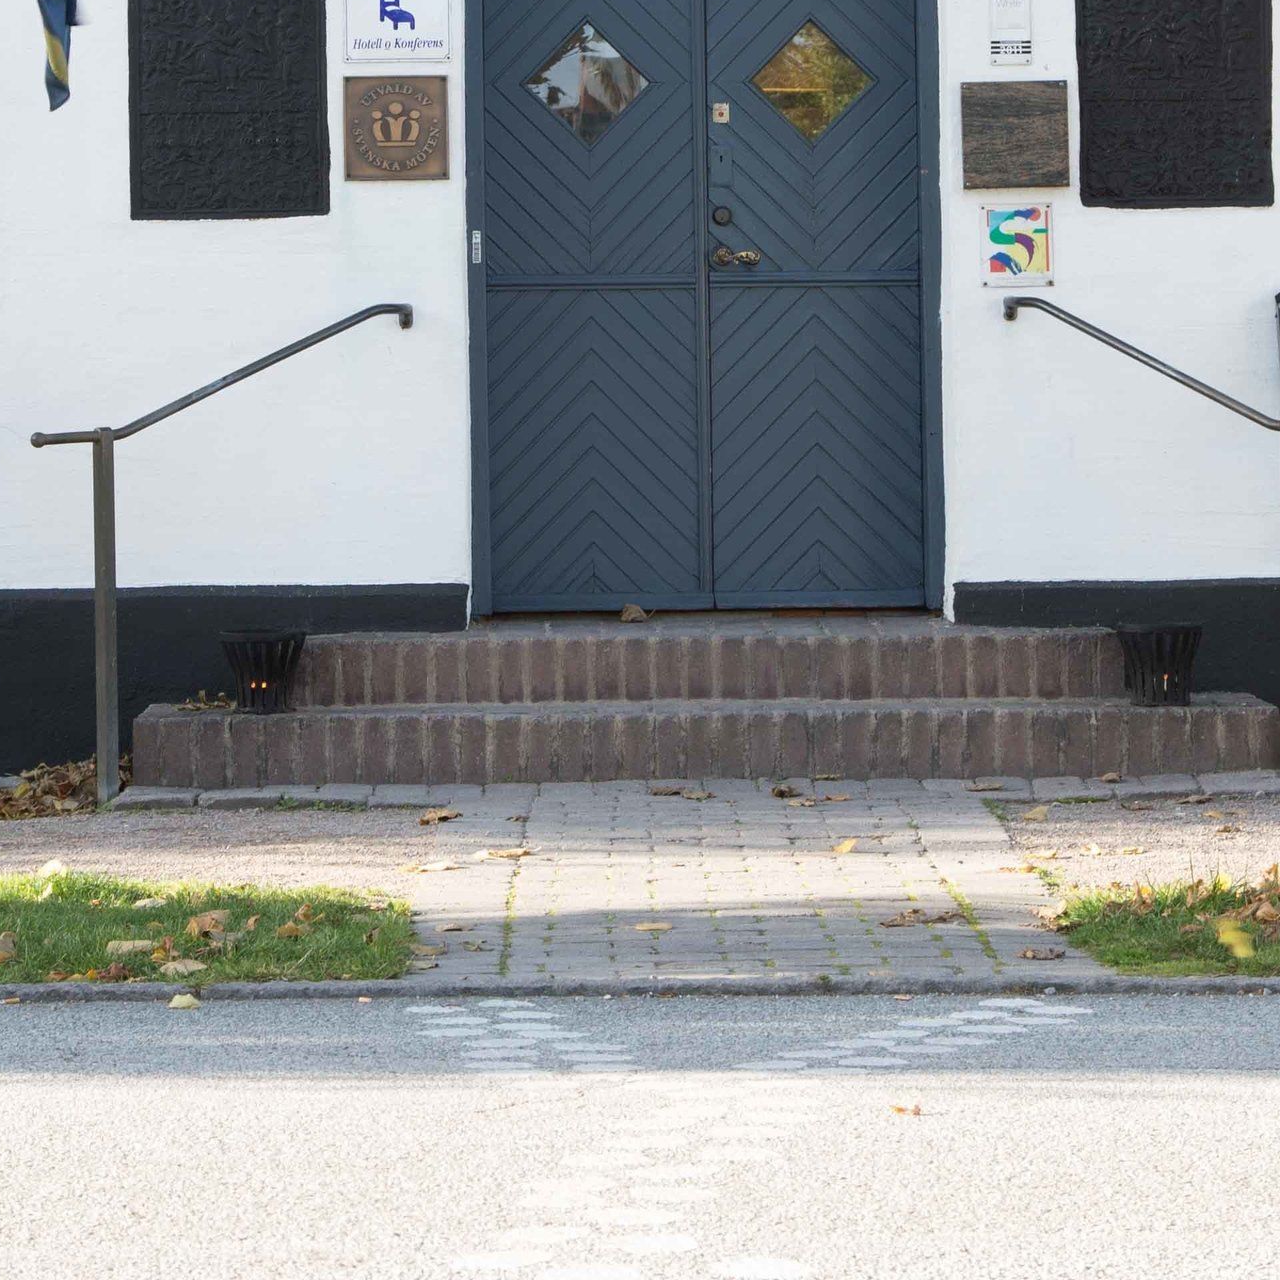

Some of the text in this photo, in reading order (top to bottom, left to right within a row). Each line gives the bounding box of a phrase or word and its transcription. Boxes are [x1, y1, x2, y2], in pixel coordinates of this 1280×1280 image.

[353, 38, 382, 50] Hotell
[394, 37, 444, 51] Konferens
[361, 84, 433, 108] UTVALD AV
[352, 126, 442, 171] SVENSKA MÖTEN
